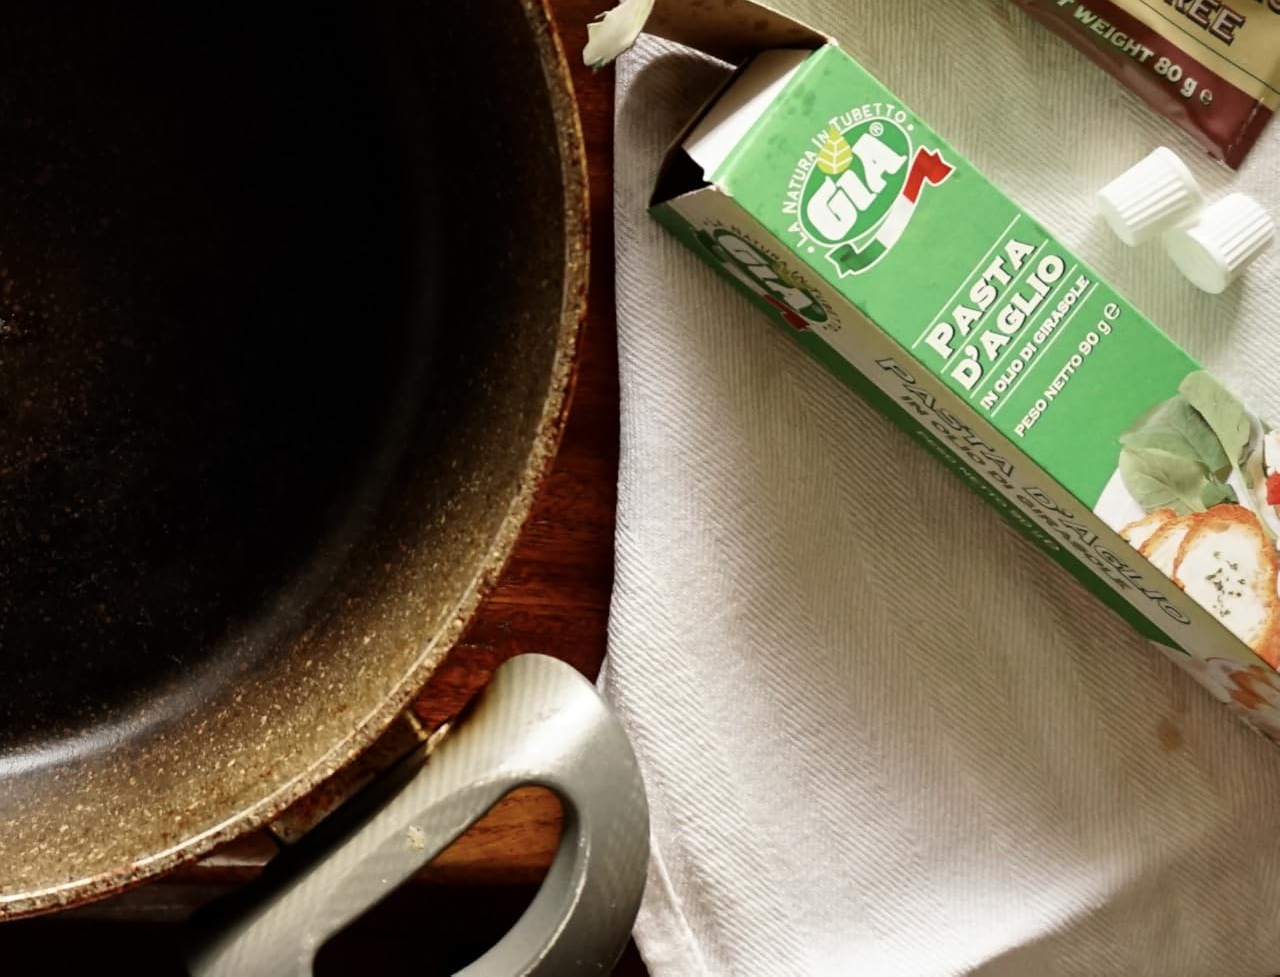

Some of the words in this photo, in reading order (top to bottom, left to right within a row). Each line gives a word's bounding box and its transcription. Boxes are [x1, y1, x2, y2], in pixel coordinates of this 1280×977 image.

[1072, 6, 1156, 64] WEIGHT
[1153, 56, 1183, 83] 80
[1181, 76, 1198, 98] g
[811, 129, 830, 149] IN
[829, 102, 907, 131] TUBETTO
[782, 150, 817, 214] NATURA
[787, 222, 809, 248] LA
[924, 238, 1037, 360] PASTA
[950, 254, 1066, 391] D'AGLIO
[979, 389, 1000, 411] IN
[994, 358, 1025, 394] OLIO
[1019, 342, 1038, 362] DI
[1032, 274, 1091, 345] GIRASOLE
[1013, 398, 1049, 438] PESO
[1043, 353, 1083, 402] NETTO
[1078, 331, 1100, 356] 90
[1097, 319, 1113, 336] g
[901, 395, 930, 416] IN
[931, 420, 986, 466] OLIO
[987, 470, 1015, 490] DI
[874, 357, 1015, 477] PASTA
[1022, 486, 1192, 625] D'AGLIO
